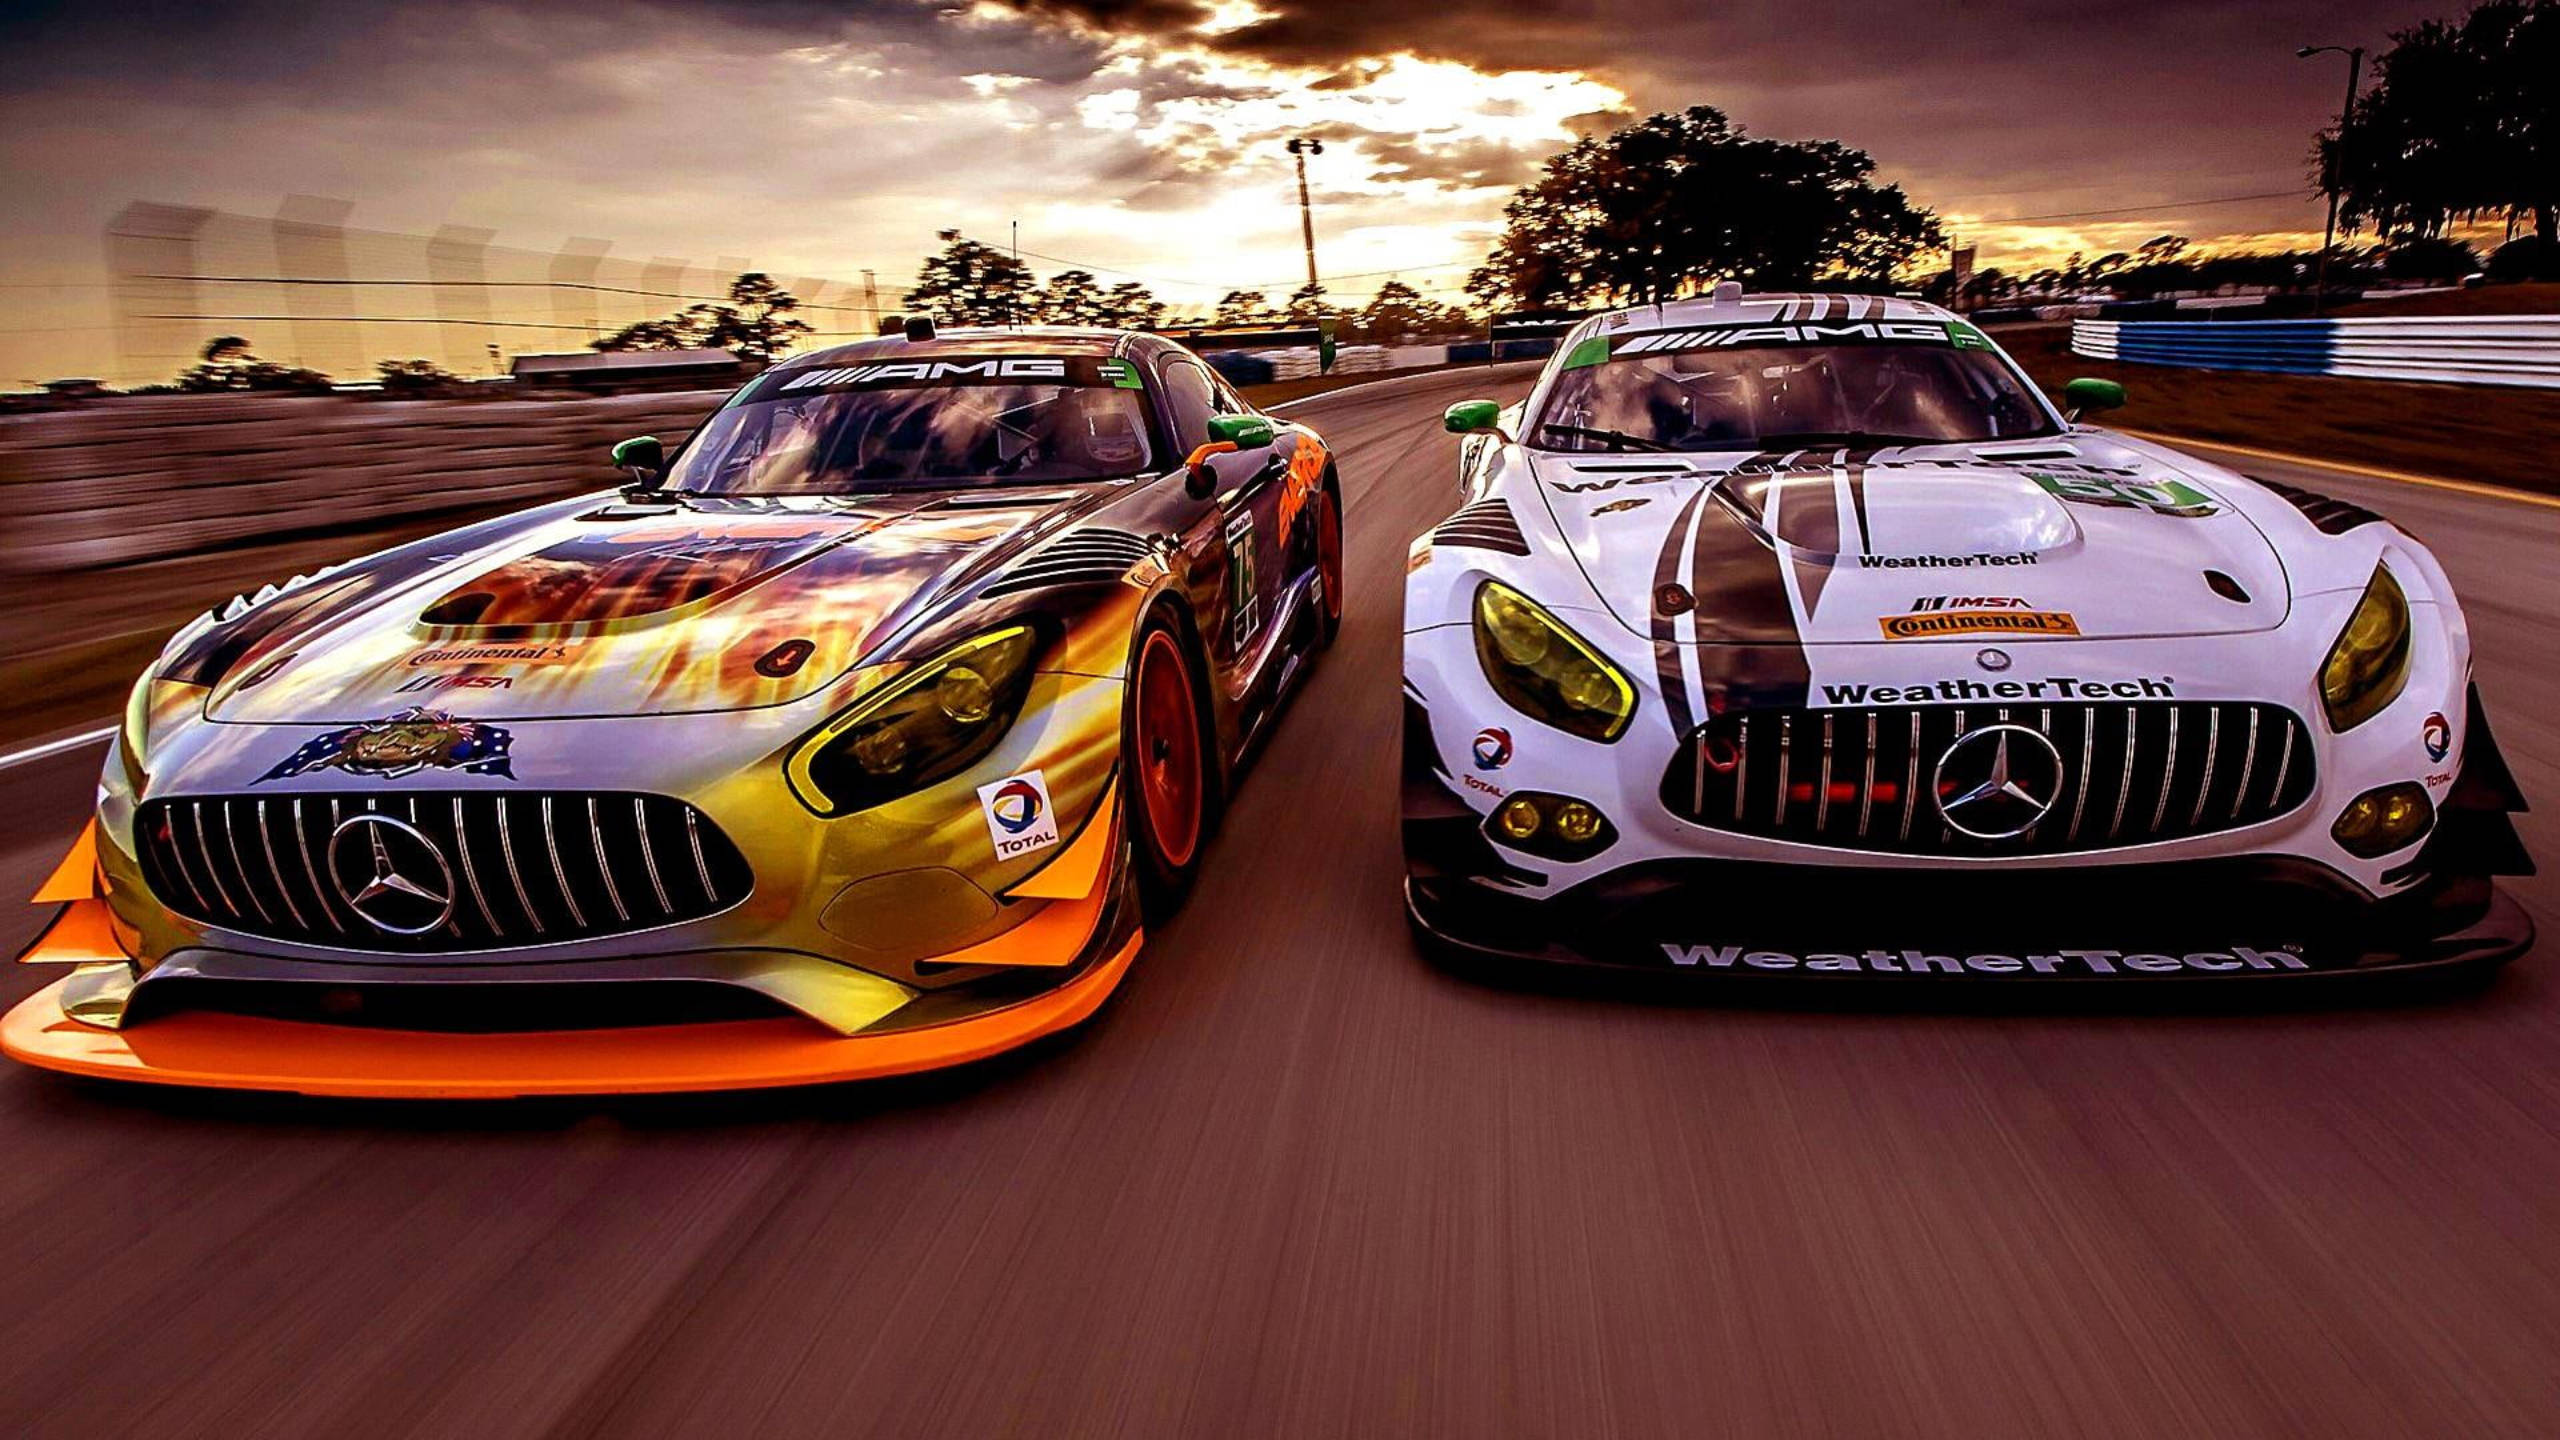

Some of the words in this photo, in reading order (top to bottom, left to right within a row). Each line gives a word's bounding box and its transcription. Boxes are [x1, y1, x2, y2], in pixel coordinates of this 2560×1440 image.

[1721, 324, 1949, 345] AMG
[860, 359, 1065, 382] AMG
[2053, 478, 2176, 505] 50
[1859, 551, 2038, 569] WeatherTech
[1950, 597, 2032, 609] IMSA
[1888, 613, 2047, 637] Continental
[408, 646, 550, 667] Continental
[1822, 676, 2175, 705] WeatherTech
[1463, 774, 1504, 797] TOTAL
[998, 831, 1055, 854] TOTAL
[1661, 943, 2308, 973] WeatherTech
